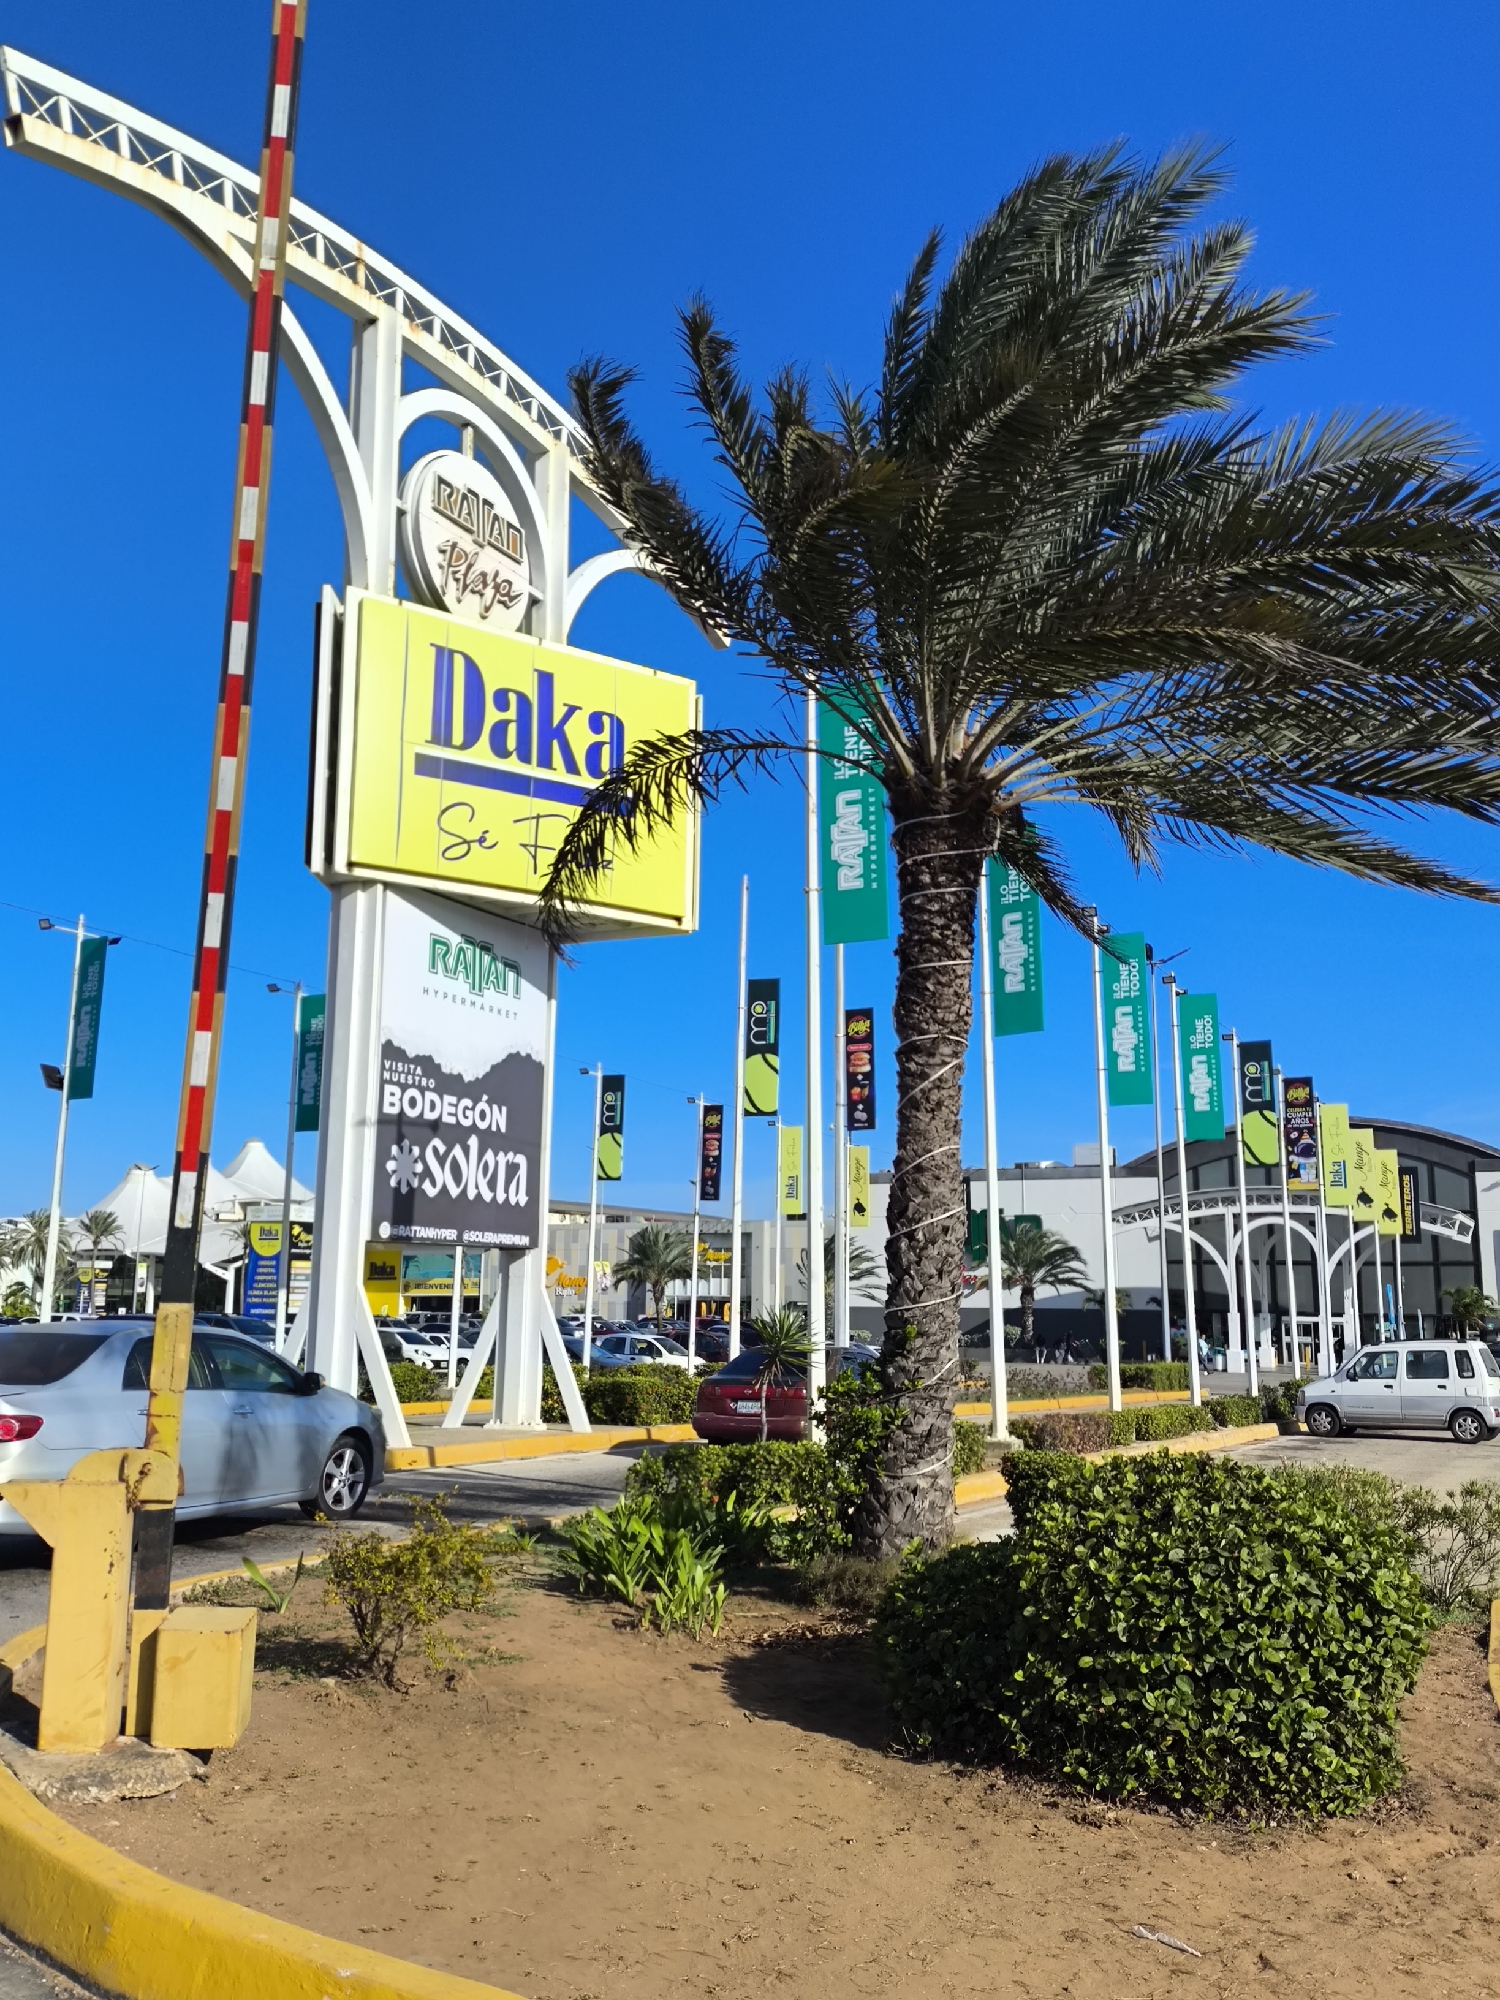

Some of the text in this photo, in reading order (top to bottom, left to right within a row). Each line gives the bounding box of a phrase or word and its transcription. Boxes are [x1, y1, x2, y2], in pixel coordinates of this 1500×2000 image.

[437, 538, 524, 619] Plaza
[425, 642, 625, 780] Daka
[437, 801, 498, 861] Sé
[868, 787, 878, 889] HYPERMARKET
[1008, 866, 1020, 904] TIEN
[1028, 910, 1036, 992] HYPERMARKET
[1119, 963, 1130, 999] TIENE
[1129, 958, 1140, 998] TODO!
[422, 986, 518, 1020] HYPERMARKET
[1195, 1018, 1204, 1049] TIENE
[1203, 1014, 1214, 1048] TODO!
[383, 1070, 436, 1089] NUESTRO
[384, 1059, 422, 1076] VISITA
[382, 1084, 508, 1133] BODEGÓN
[421, 1134, 529, 1207] Solera
[1329, 1160, 1343, 1187] Daka
[1354, 1141, 1369, 1181] Mango
[1379, 1161, 1394, 1198] Mango
[1403, 1174, 1413, 1235] FERRETEROS
[391, 1224, 531, 1246] @RATTANHYPER @SOLERAPREMIUM
[369, 1262, 396, 1277] Daka
[556, 1271, 587, 1295] Mang
